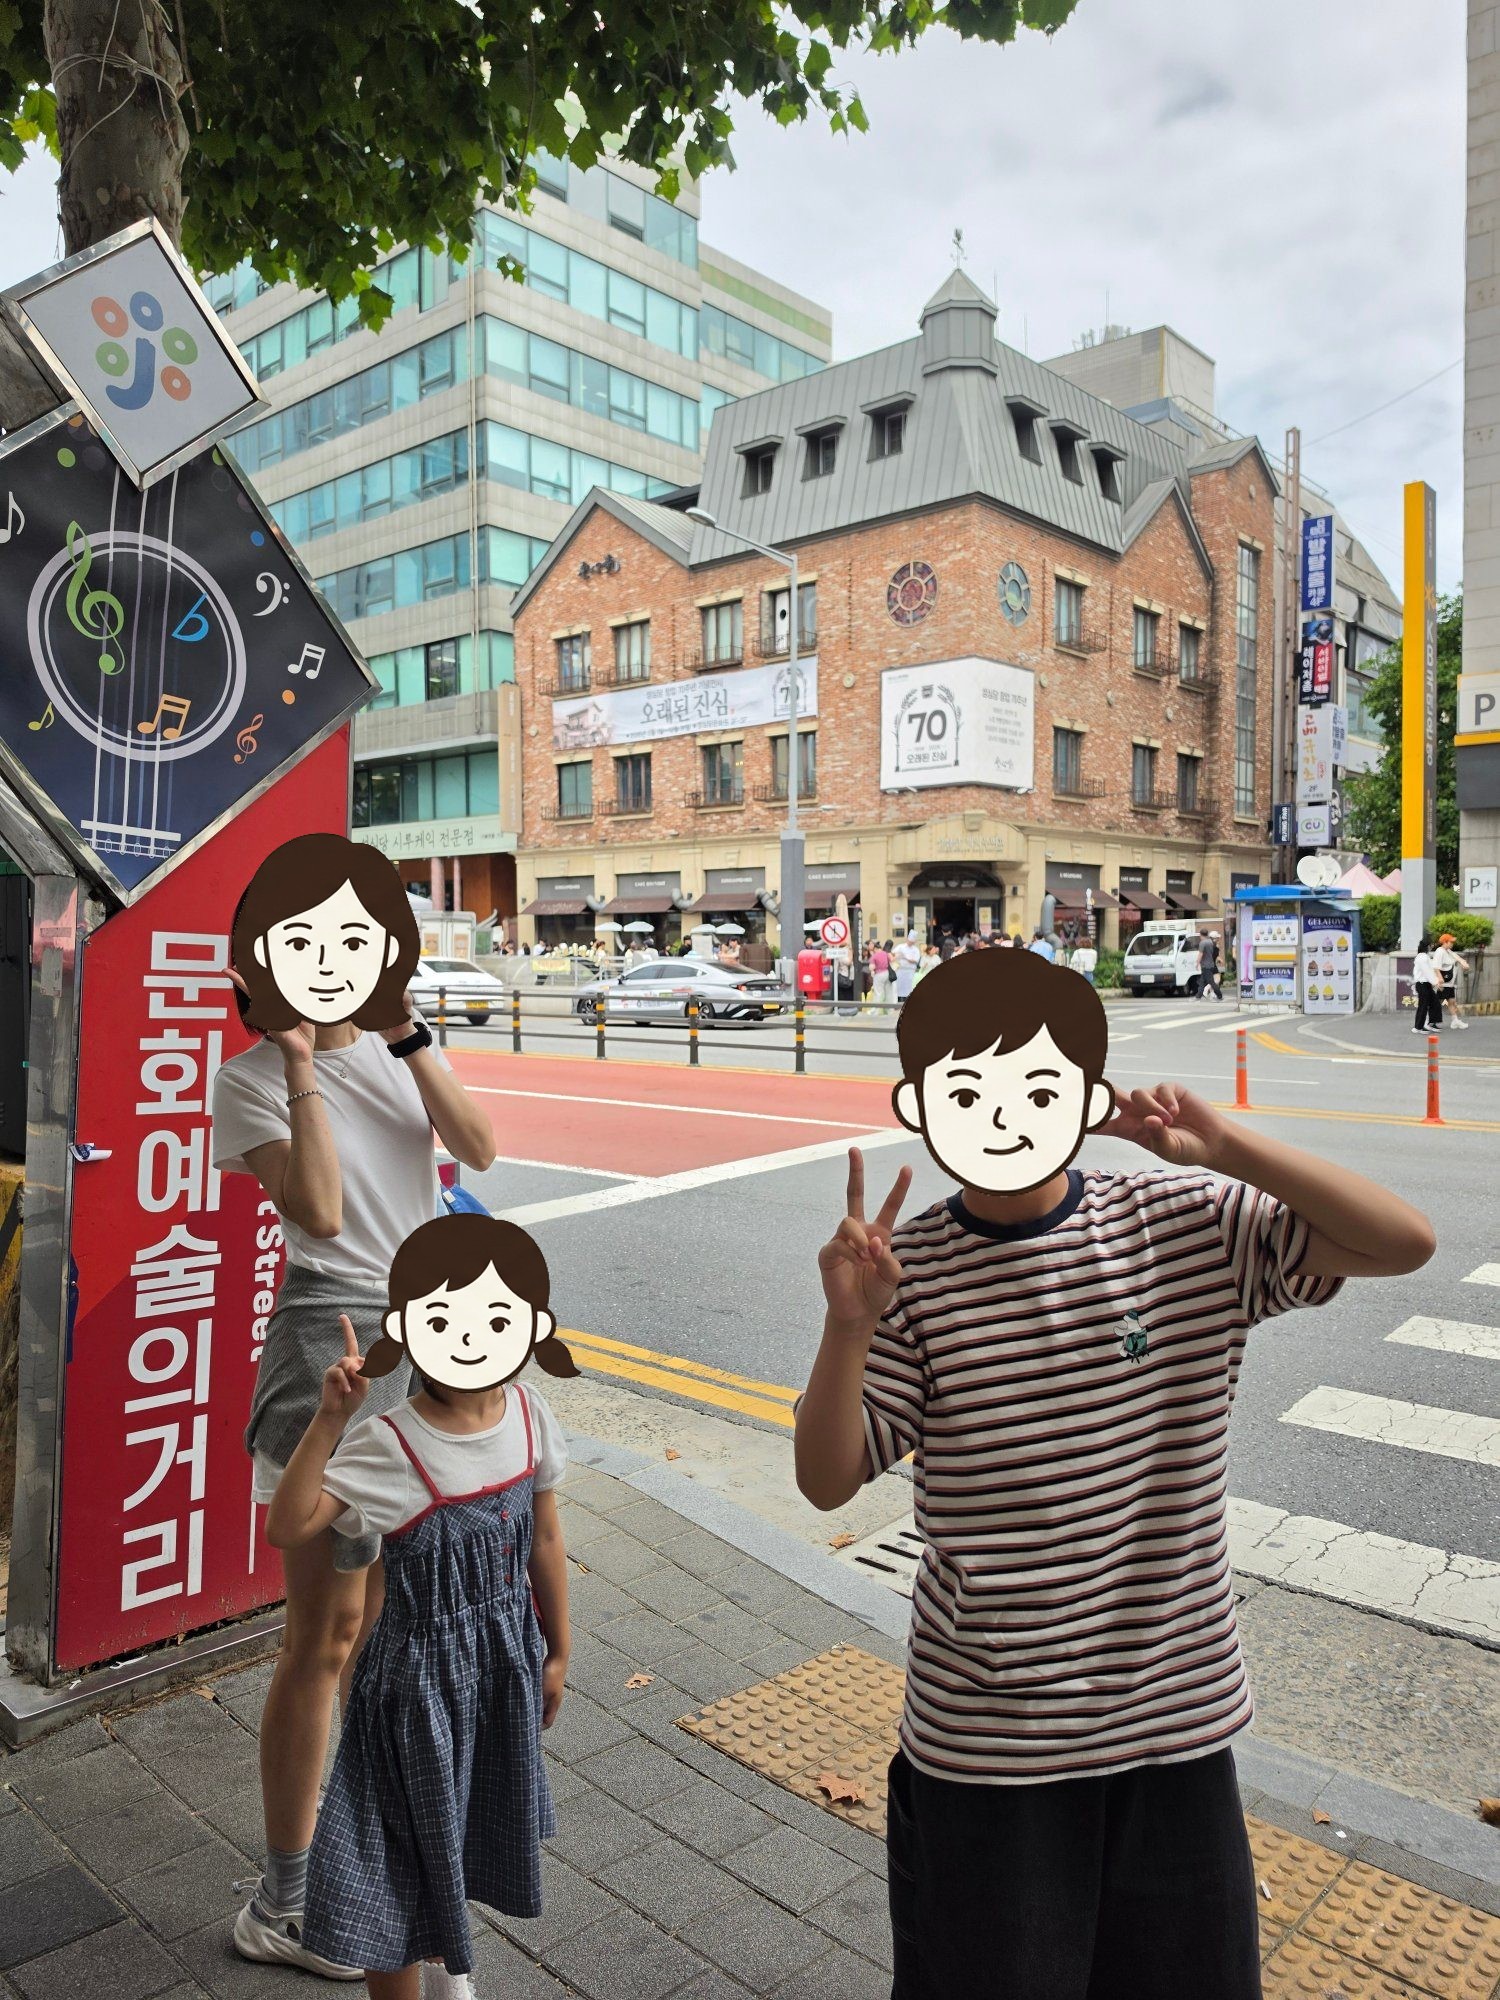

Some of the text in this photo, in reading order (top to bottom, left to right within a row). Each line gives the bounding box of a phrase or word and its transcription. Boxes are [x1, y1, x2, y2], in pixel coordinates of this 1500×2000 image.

[640, 688, 729, 724] 오래된 진심
[1474, 692, 1496, 726] P
[907, 709, 947, 743] 70
[906, 753, 930, 765] 오래된
[1305, 821, 1320, 830] CU
[439, 826, 474, 849] 전문점
[1469, 878, 1481, 894] P
